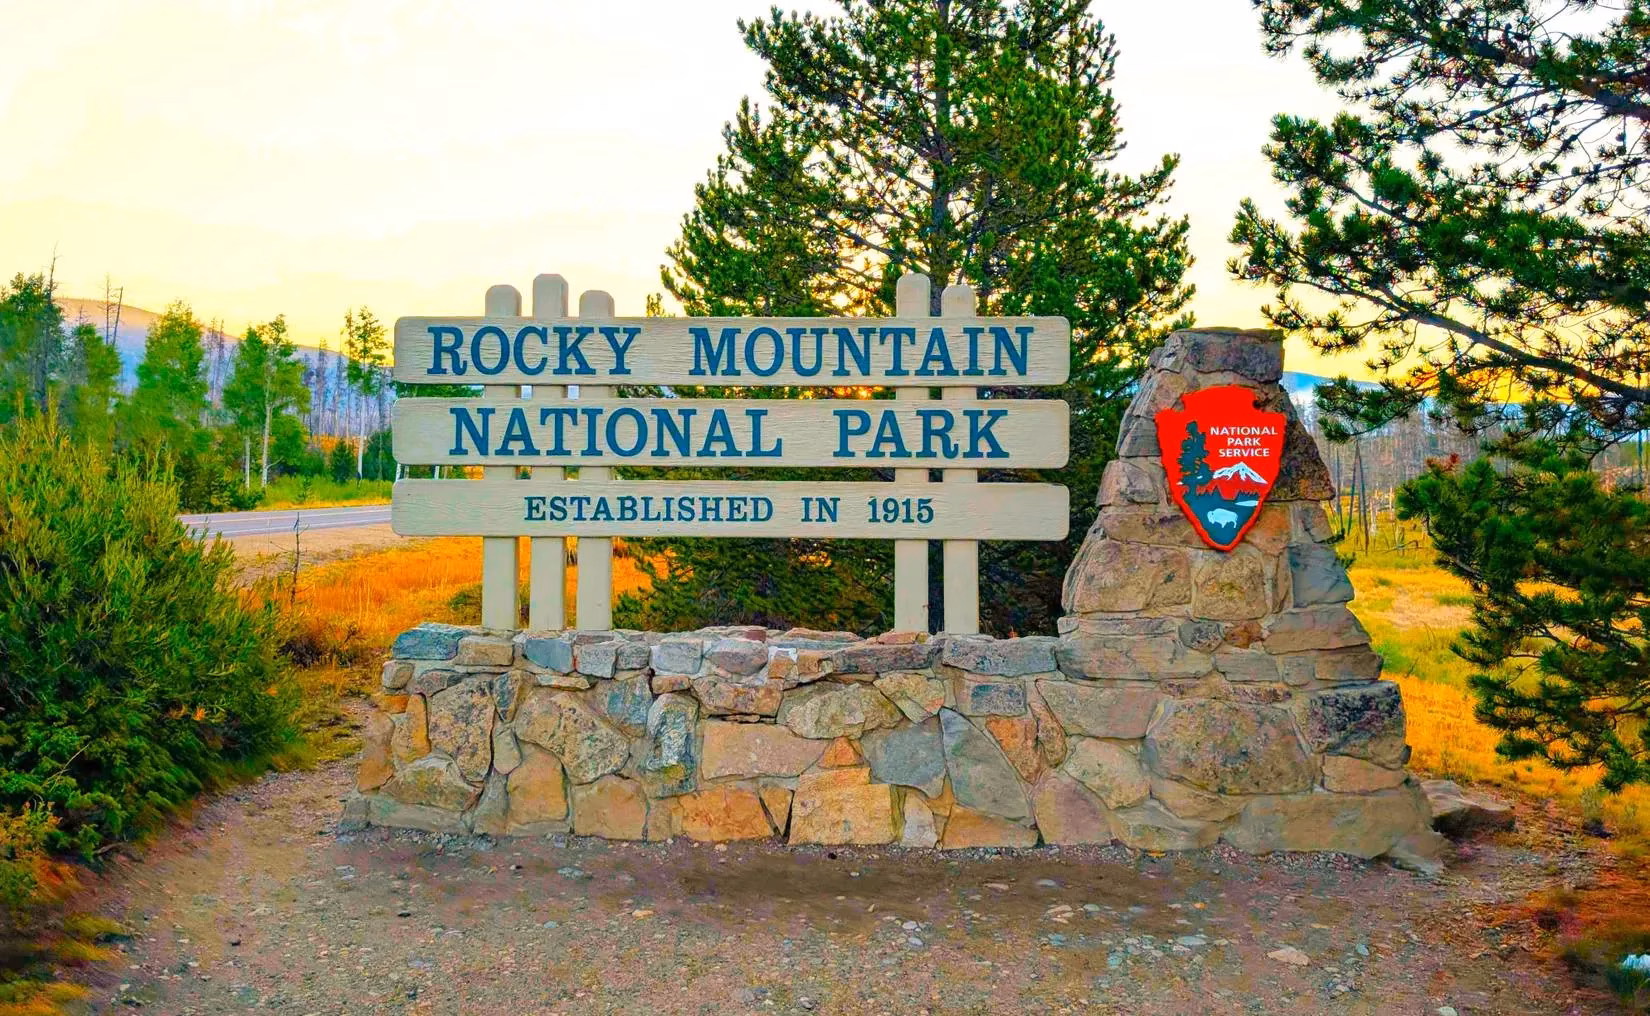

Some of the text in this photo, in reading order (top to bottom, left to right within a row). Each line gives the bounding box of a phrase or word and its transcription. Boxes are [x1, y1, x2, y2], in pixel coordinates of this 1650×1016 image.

[427, 326, 1034, 376] ROCKY MOUNTAIN
[449, 408, 1008, 458] NATIONAL PARK
[1210, 426, 1277, 436] NATIONAL
[1227, 437, 1261, 447] PARK
[1219, 447, 1270, 458] SERVICE
[526, 496, 934, 523] ESTABLISHED IN 1915
